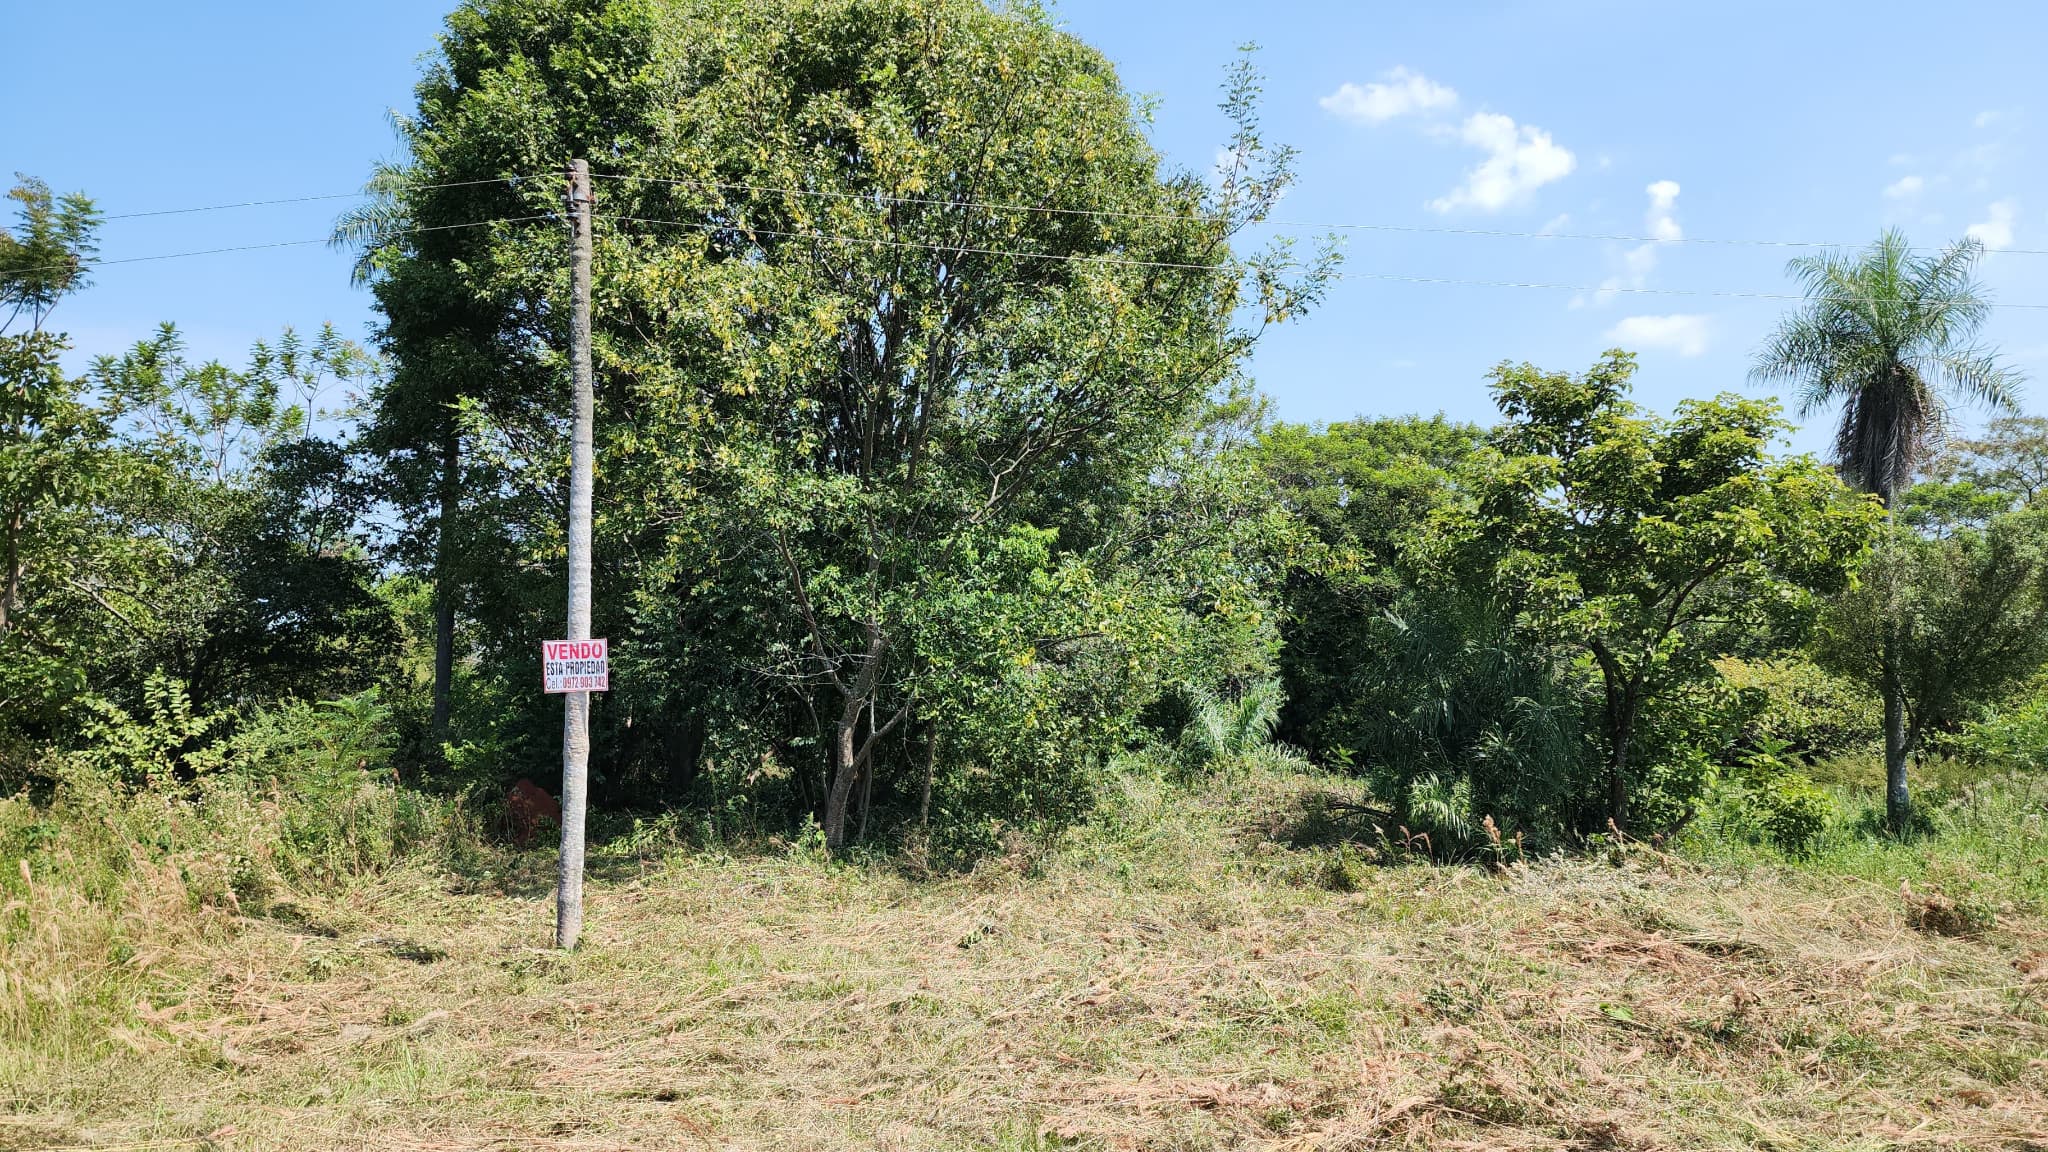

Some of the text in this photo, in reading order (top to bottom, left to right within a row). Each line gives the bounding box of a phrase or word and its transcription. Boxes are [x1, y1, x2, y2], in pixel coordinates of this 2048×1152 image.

[547, 643, 603, 660] VENDO
[546, 661, 605, 676] ESTA PROPIEDAD
